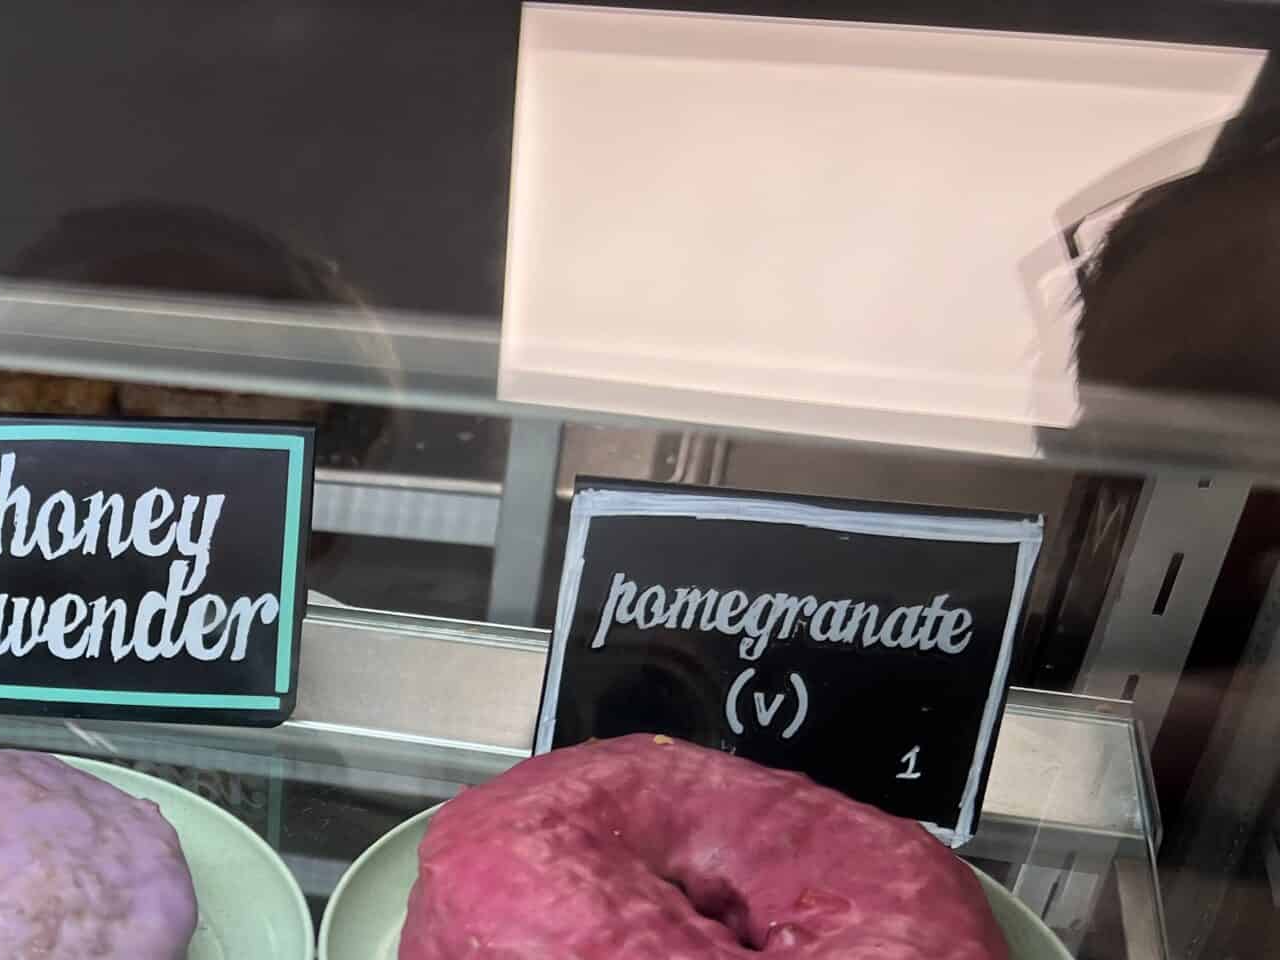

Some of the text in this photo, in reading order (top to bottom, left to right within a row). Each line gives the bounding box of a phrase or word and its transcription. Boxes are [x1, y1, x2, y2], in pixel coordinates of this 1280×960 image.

[591, 571, 974, 662] pomegranate
[725, 667, 810, 740] (v)
[896, 745, 922, 780] 1
